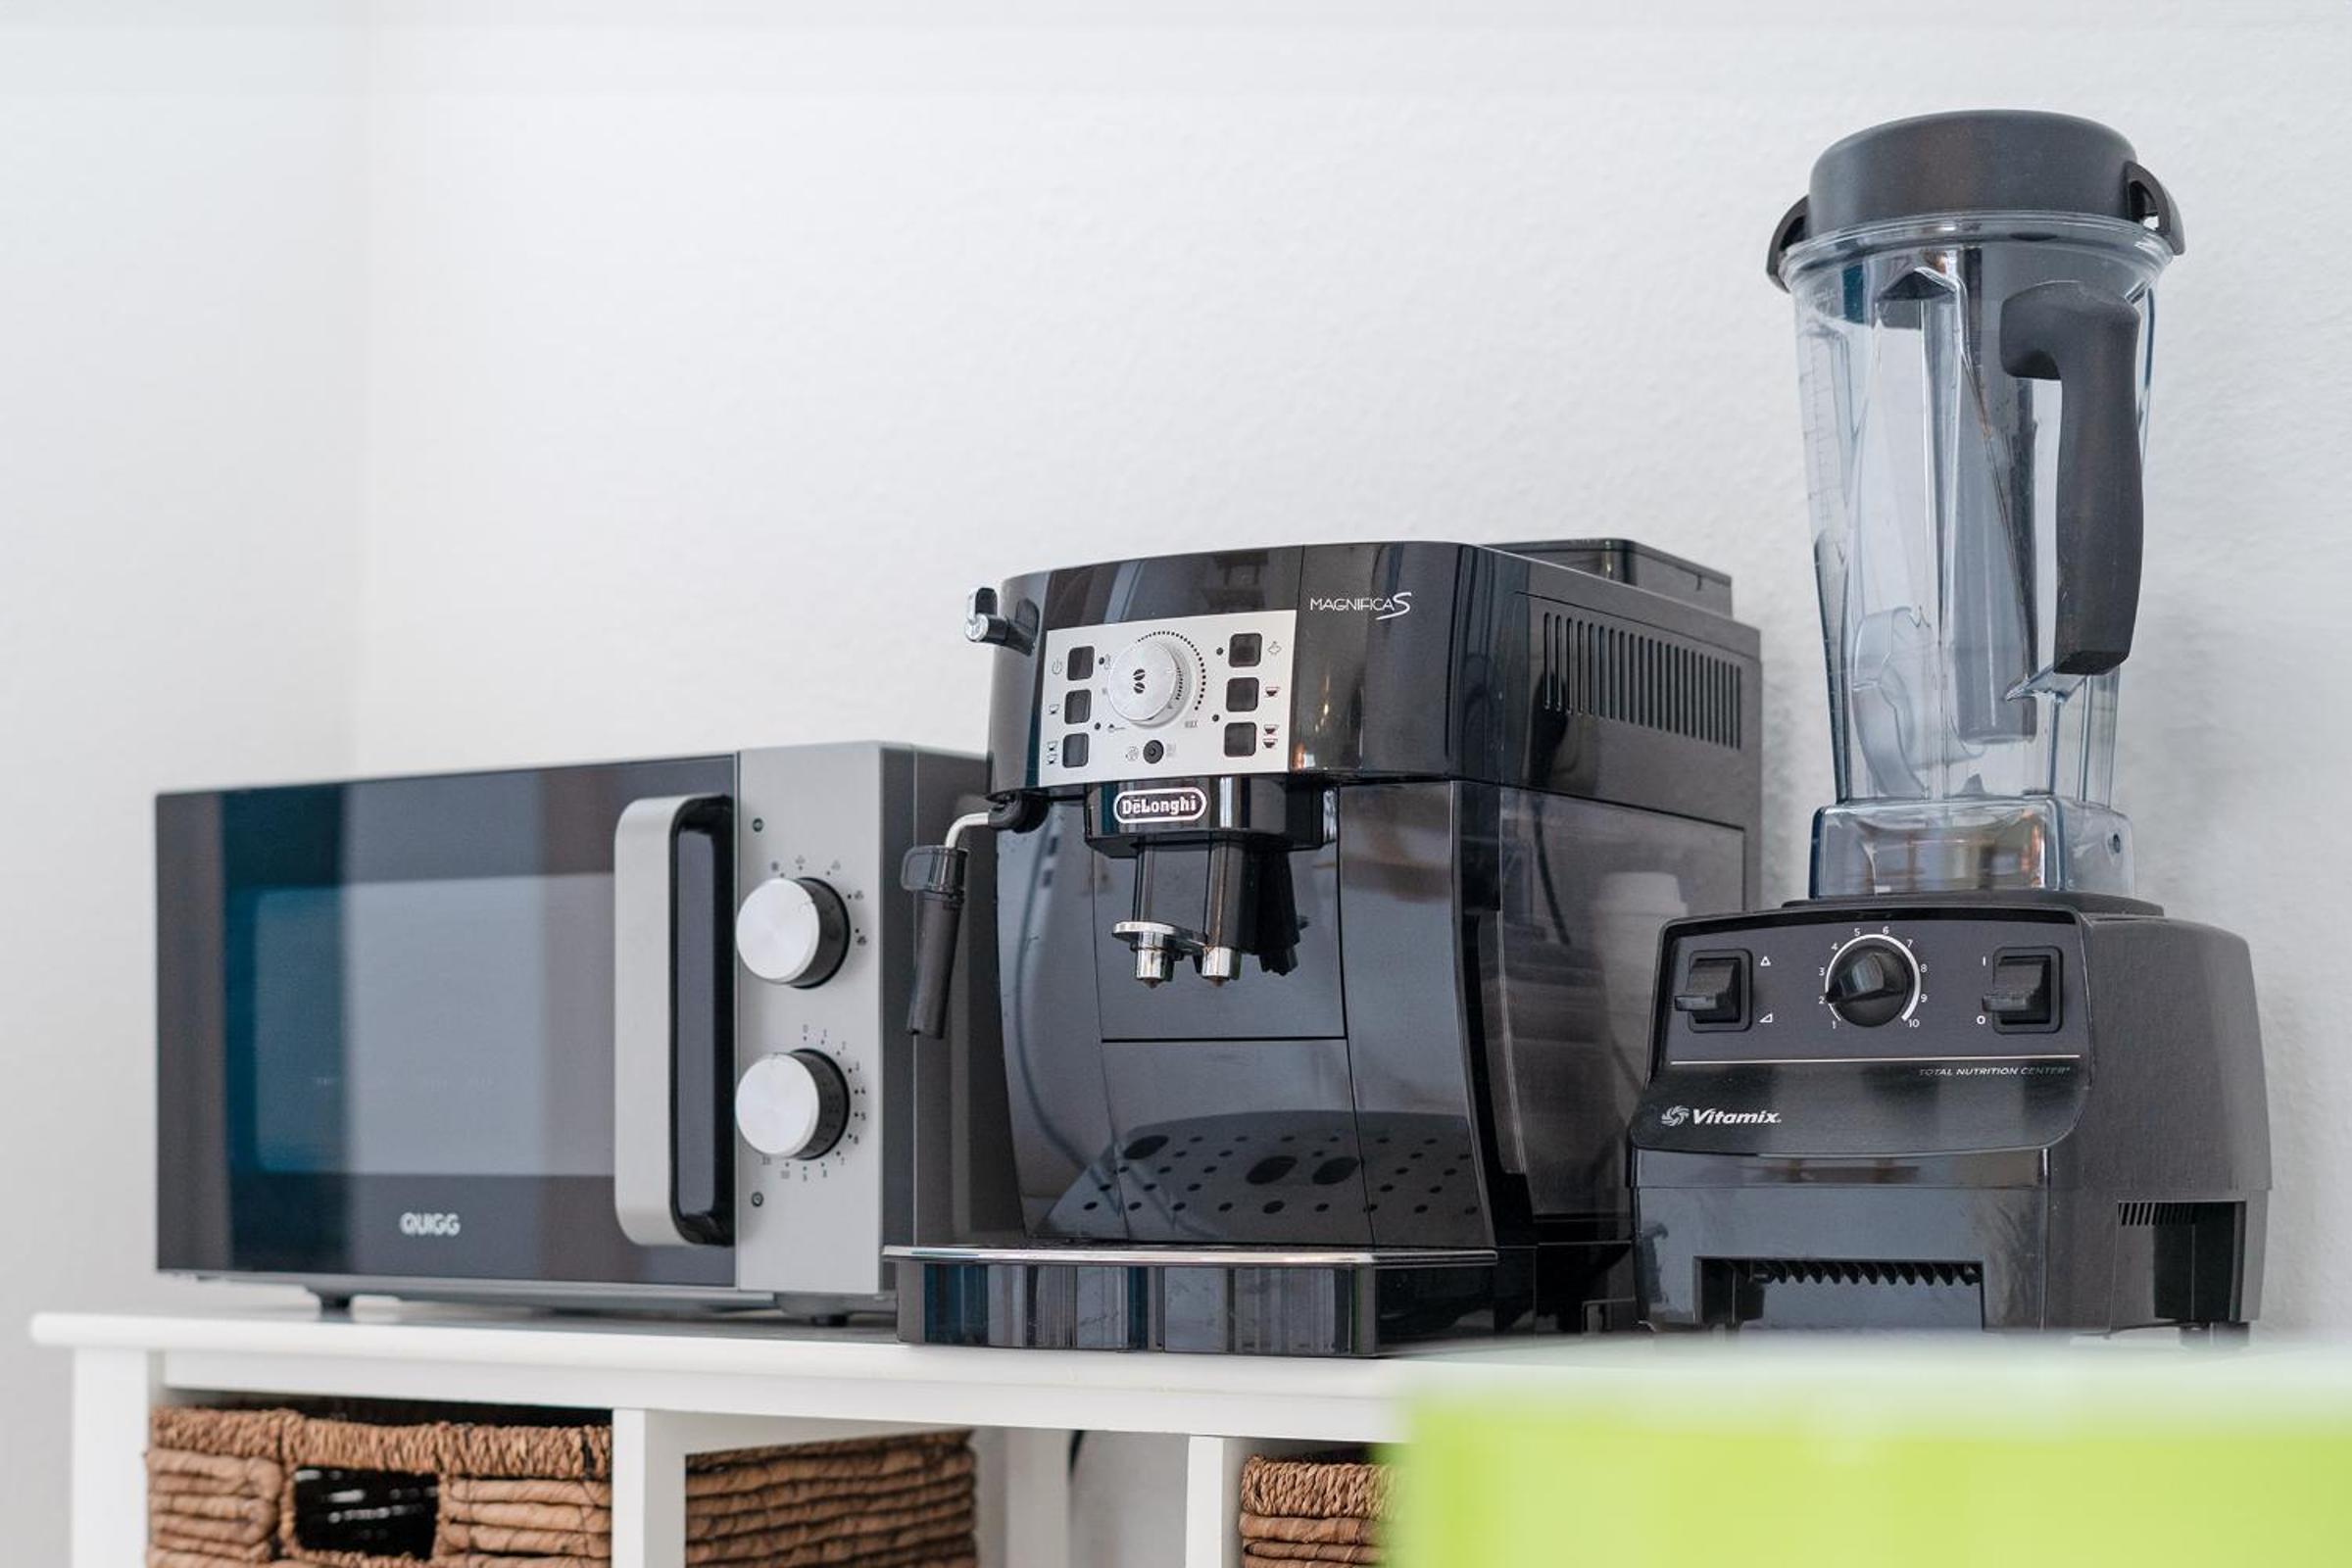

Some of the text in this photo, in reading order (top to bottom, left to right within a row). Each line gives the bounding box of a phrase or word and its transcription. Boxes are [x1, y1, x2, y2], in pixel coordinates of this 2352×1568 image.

[1309, 597, 1395, 612] MAGNIFICA
[1854, 927, 1861, 936] 5
[1883, 926, 1889, 935] 6
[1907, 939, 1914, 948] 7
[1819, 967, 1825, 976] 3
[1921, 963, 1928, 973] 8
[1921, 994, 1928, 1003] 9
[1908, 1019, 1920, 1028] 10
[1919, 1067, 1953, 1076] TOTAL
[1956, 1066, 2019, 1076] NUTRITION
[1693, 1107, 1780, 1124] Vitamix
[399, 1211, 462, 1236] QUIGG
